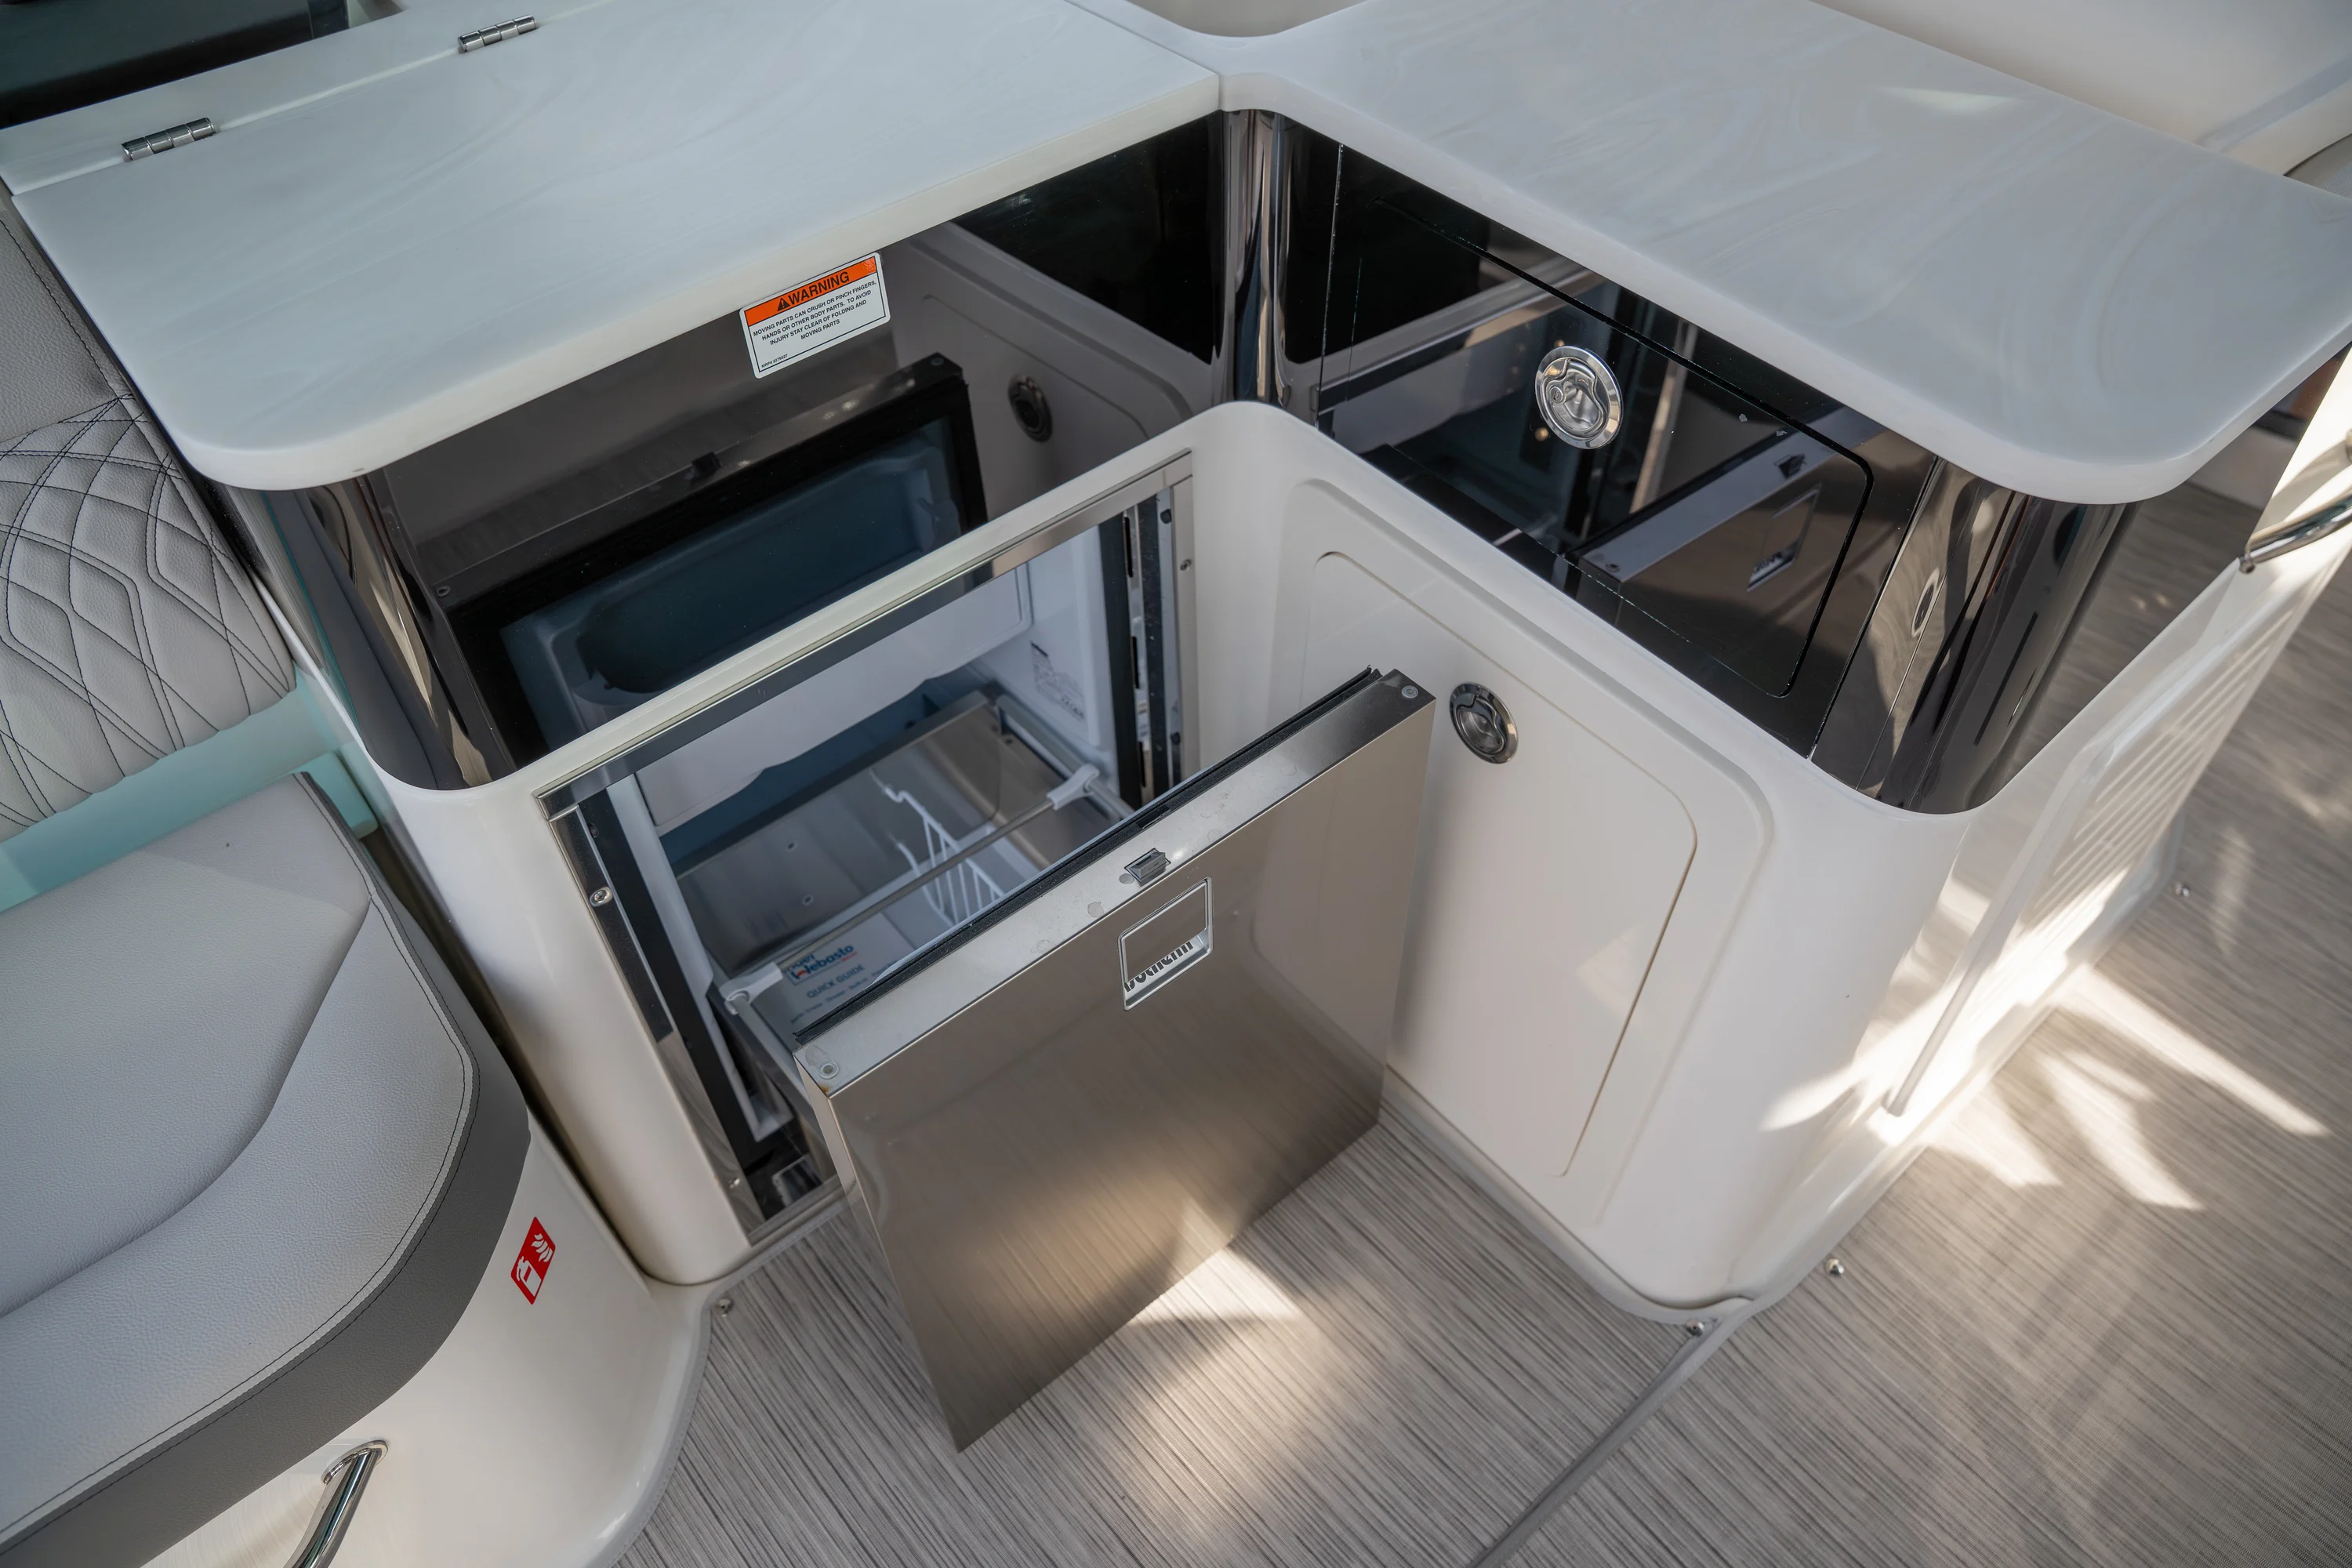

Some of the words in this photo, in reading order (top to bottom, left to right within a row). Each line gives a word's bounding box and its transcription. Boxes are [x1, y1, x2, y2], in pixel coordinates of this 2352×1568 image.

[788, 271, 850, 305] WARNING
[753, 323, 775, 337] MOVING
[775, 315, 794, 327] PARTS
[794, 310, 807, 318] CAN
[807, 301, 826, 314] CRUSH
[835, 290, 852, 301] PINCH
[852, 280, 877, 294] FINGERS,
[761, 328, 782, 341] HANDS
[790, 316, 810, 328] OTHER
[810, 309, 826, 320] BODY
[826, 301, 844, 313] PARTS.
[855, 289, 872, 300] AVOID
[769, 332, 789, 346] INJURY
[789, 326, 804, 336] STAY
[804, 318, 822, 330] CLEAR
[831, 305, 855, 318] FOLDING
[855, 299, 867, 308] AND
[800, 327, 822, 339] MOVING
[822, 318, 840, 330] PARTS
[807, 980, 836, 998] QUICK
[836, 964, 865, 982] GUIDE
